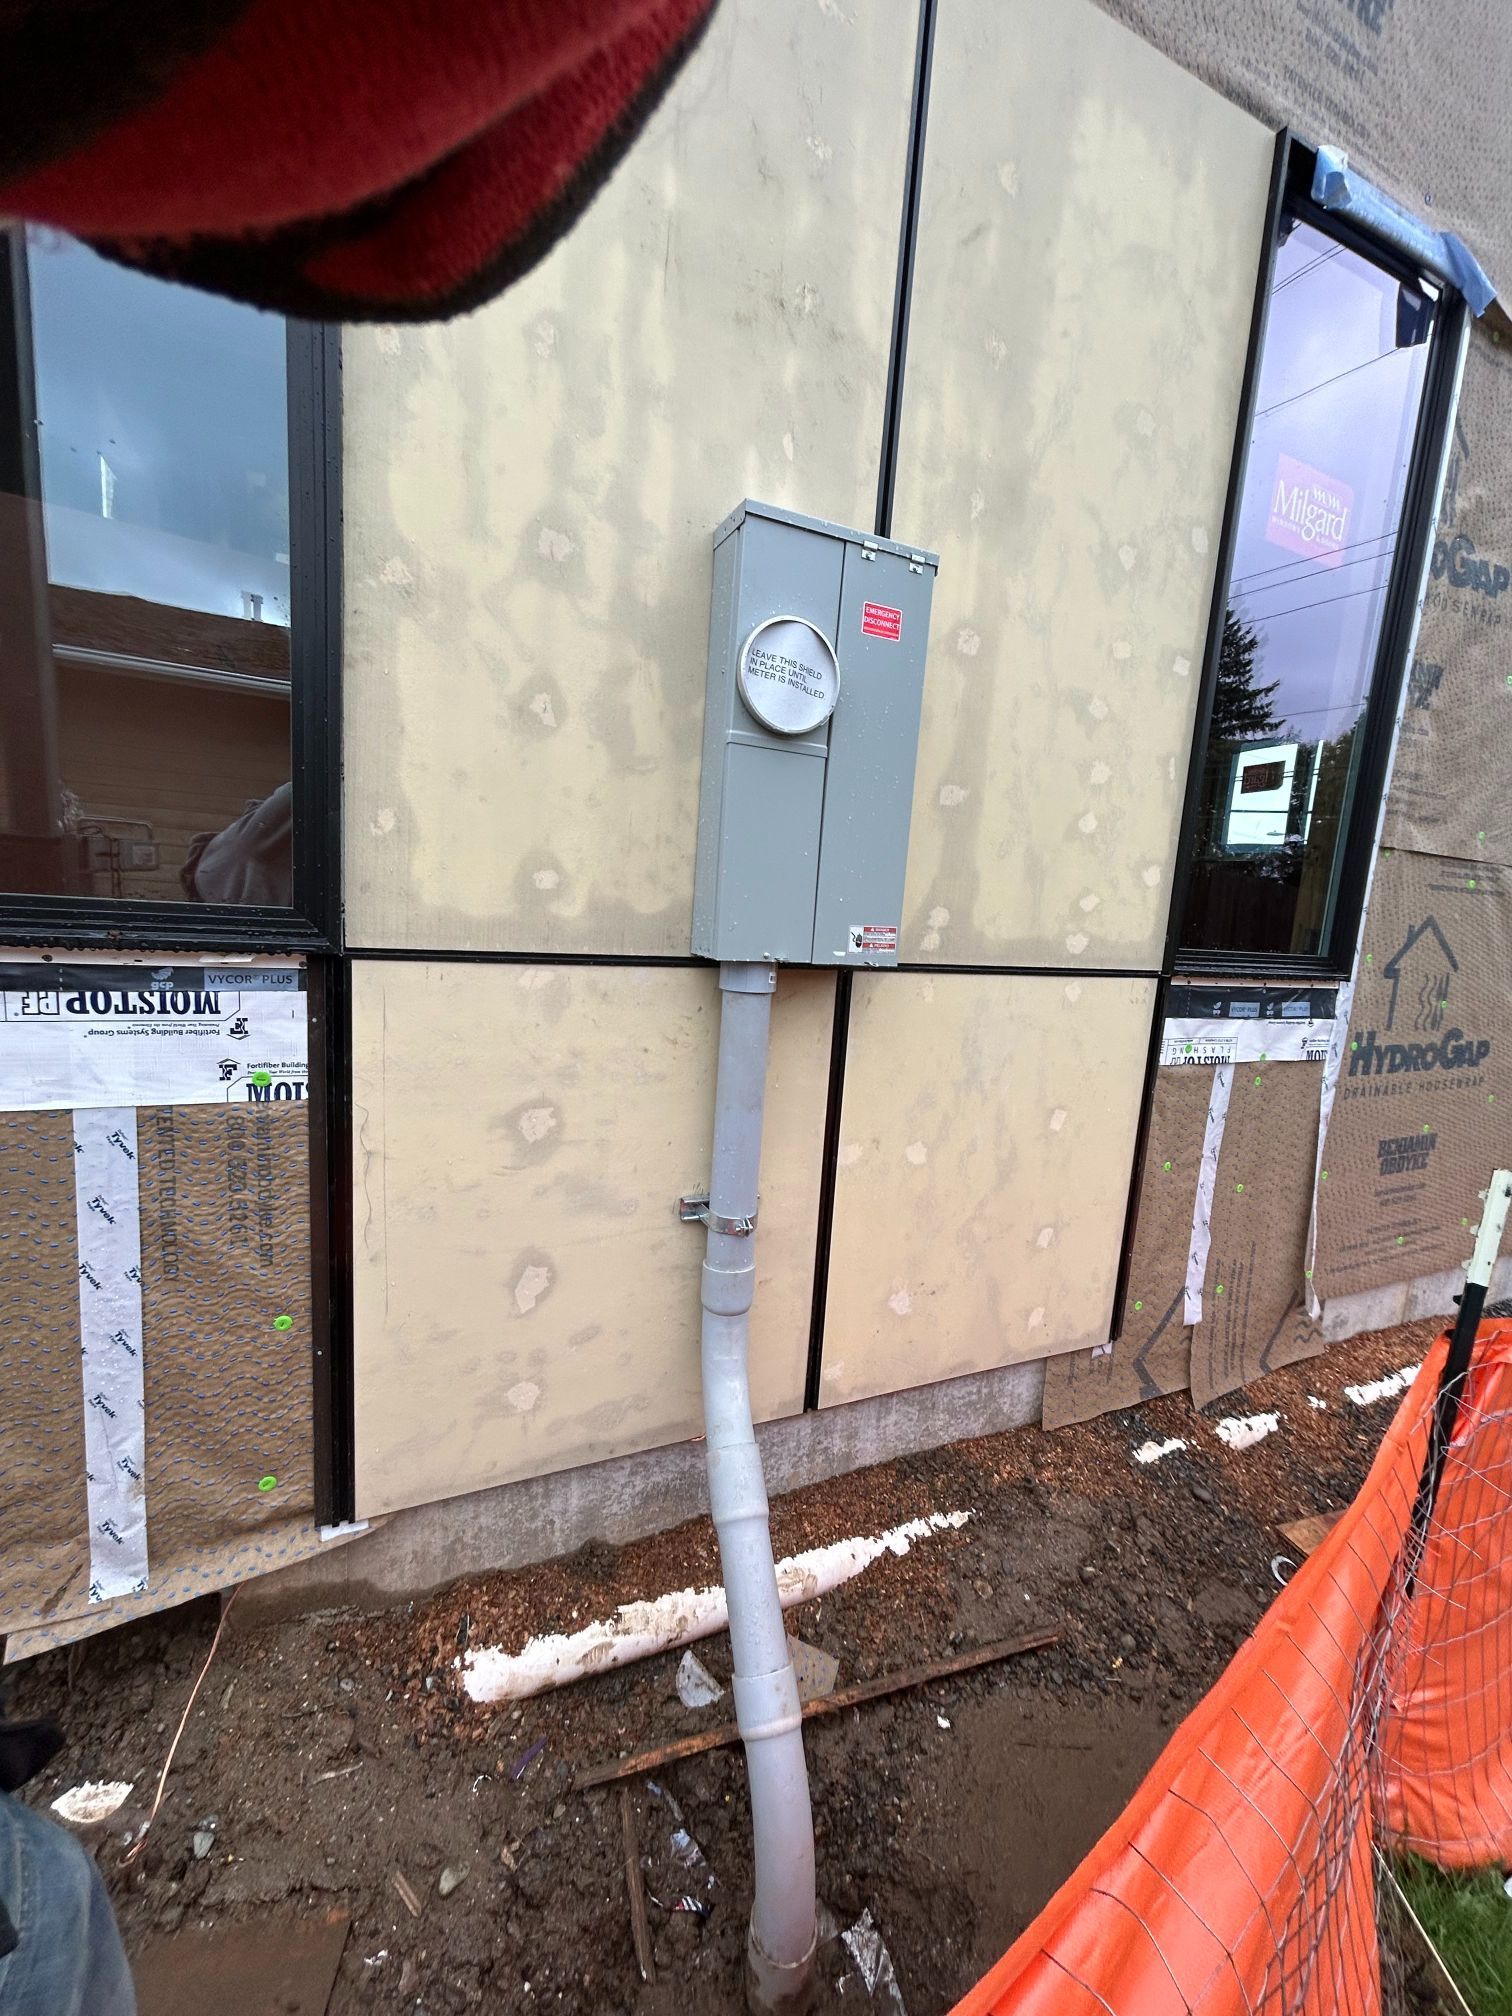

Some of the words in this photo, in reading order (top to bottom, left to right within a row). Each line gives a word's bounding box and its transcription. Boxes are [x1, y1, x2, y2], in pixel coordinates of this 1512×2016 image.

[1274, 480, 1348, 541] Milgard
[864, 616, 900, 630] DISCONNECT
[865, 606, 900, 621] EMERGENCY
[750, 657, 758, 666] IN
[759, 661, 786, 674] PLACE
[788, 669, 807, 684] UNTIL
[752, 648, 777, 662] LEAVE
[780, 656, 797, 669] THIS
[798, 664, 823, 680] SHIELD
[748, 666, 776, 681] METER
[778, 675, 786, 684] IS
[788, 678, 825, 699] INSTALLED
[151, 981, 174, 991] gcp
[208, 974, 252, 985] VYCOR
[262, 974, 293, 985] PLUS
[66, 991, 221, 1015] MOISTOP
[117, 1028, 150, 1036] Systems
[151, 1028, 184, 1036] Building
[1172, 1046, 1232, 1056] FLASHNG
[1343, 1082, 1413, 1100] DRAINABLE
[1419, 1076, 1485, 1093] HOUSEWRAP
[111, 1131, 135, 1160] Tyvek
[156, 1105, 177, 1171] TENTED
[92, 1197, 116, 1225] Tyvek
[158, 1176, 180, 1282] TECHNOLOGY
[79, 1263, 103, 1291] Tyvek
[114, 1331, 138, 1357] Tyvek
[93, 1394, 118, 1419] Tyvek
[121, 1457, 142, 1482] Tyvek
[101, 1520, 125, 1545] Tyvek
